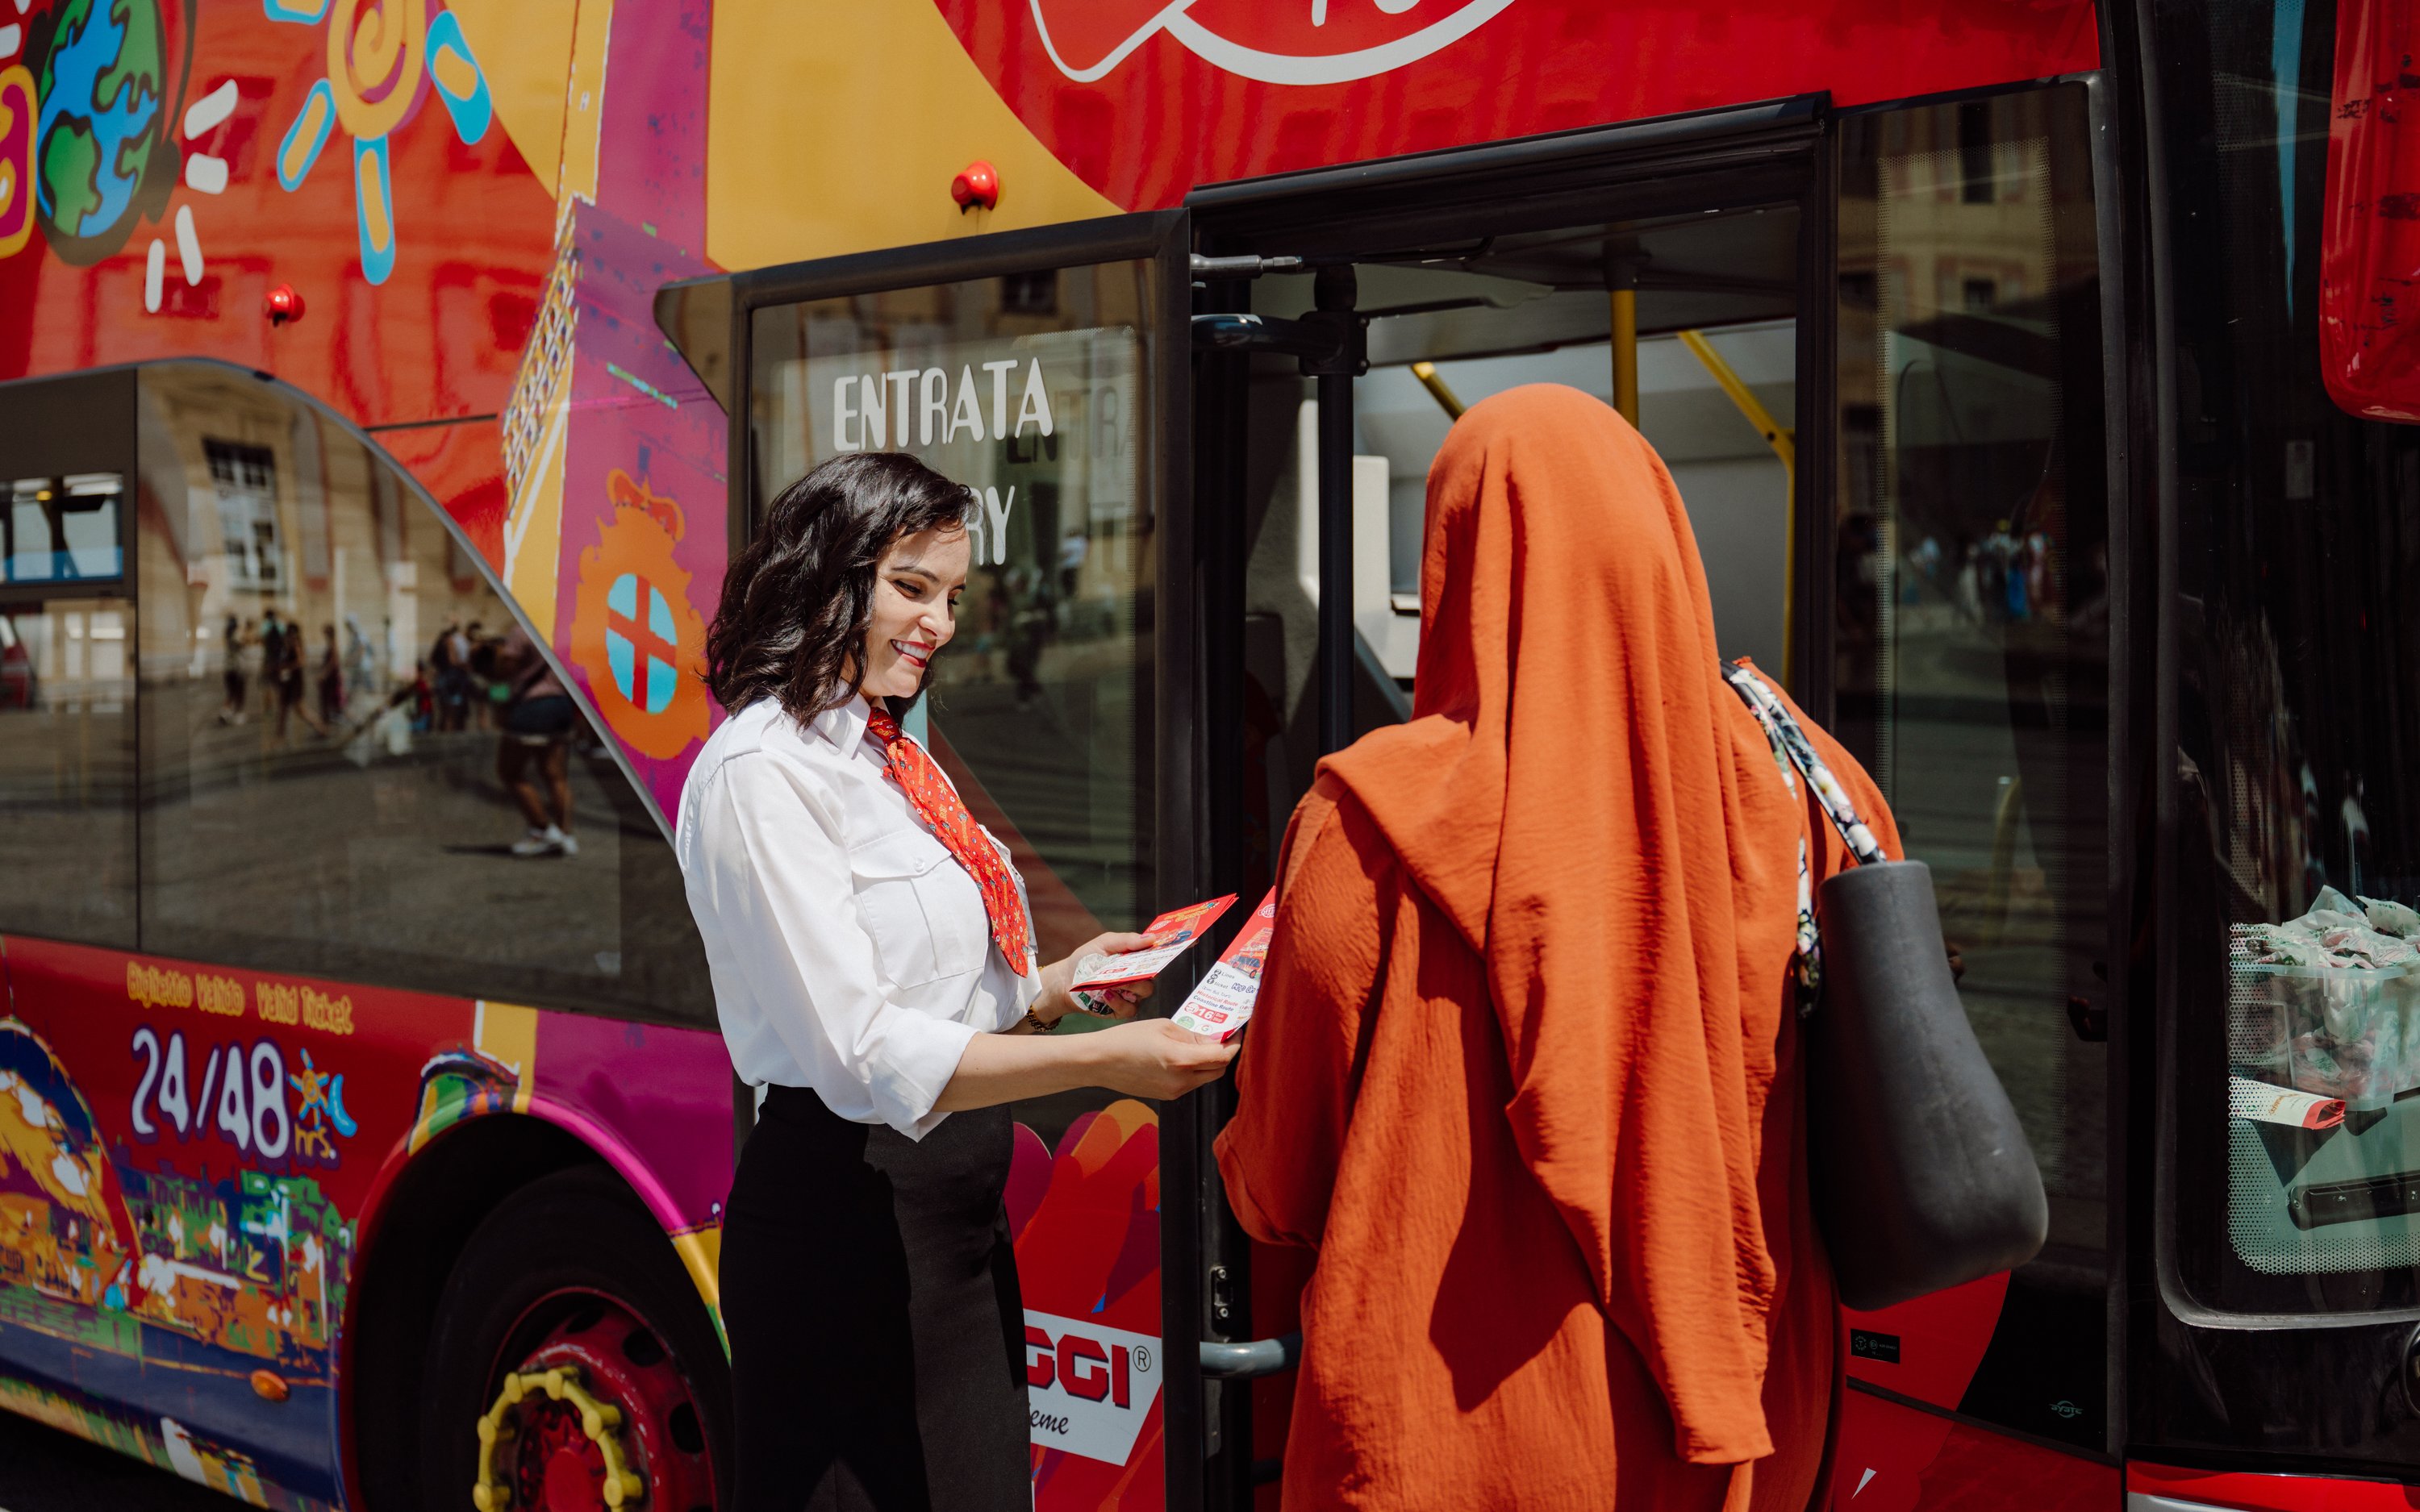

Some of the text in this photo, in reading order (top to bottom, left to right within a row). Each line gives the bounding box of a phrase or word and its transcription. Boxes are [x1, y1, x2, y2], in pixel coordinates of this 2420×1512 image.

[833, 356, 1054, 452] ENTRATA
[127, 960, 355, 1036] Biglietto Valido Valid Ticket
[1193, 995, 1218, 1007] Coastline
[1218, 1004, 1234, 1012] Route
[1197, 990, 1224, 1003] Historical
[1198, 1008, 1214, 1020] 16
[131, 1027, 290, 1160] 24/48
[1029, 1408, 1070, 1435] eme
